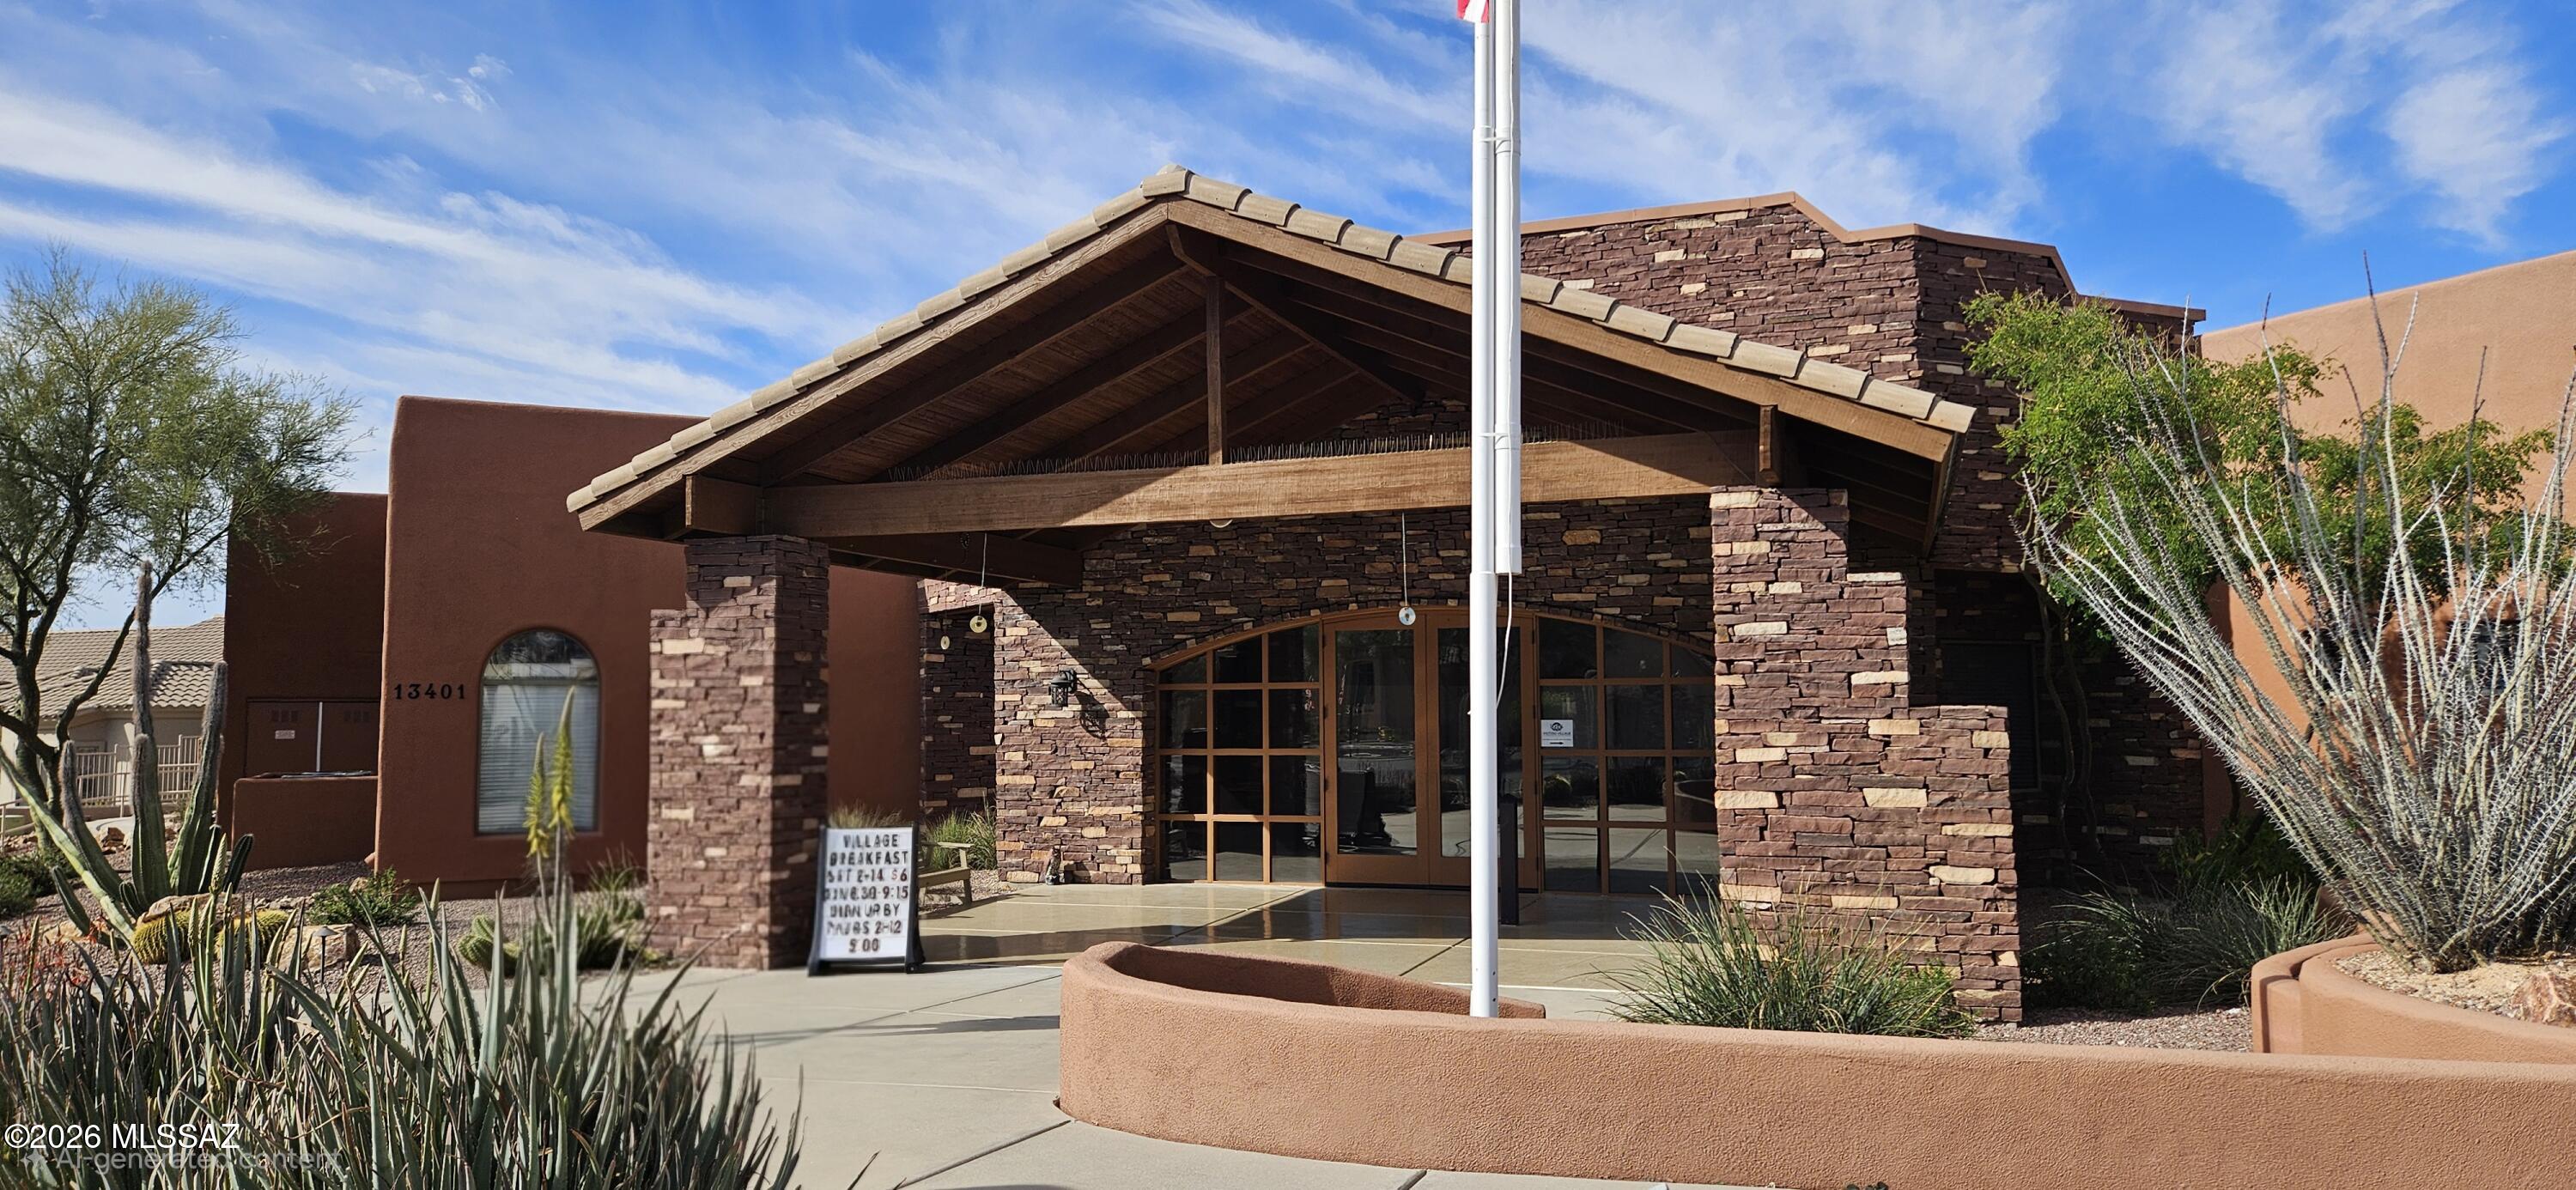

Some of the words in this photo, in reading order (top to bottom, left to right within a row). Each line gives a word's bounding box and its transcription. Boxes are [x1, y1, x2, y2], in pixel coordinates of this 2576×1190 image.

[394, 683, 465, 700] 13401
[843, 834, 899, 848] VILLAGE
[829, 851, 908, 866] BREAKFAST
[884, 903, 901, 916] BY
